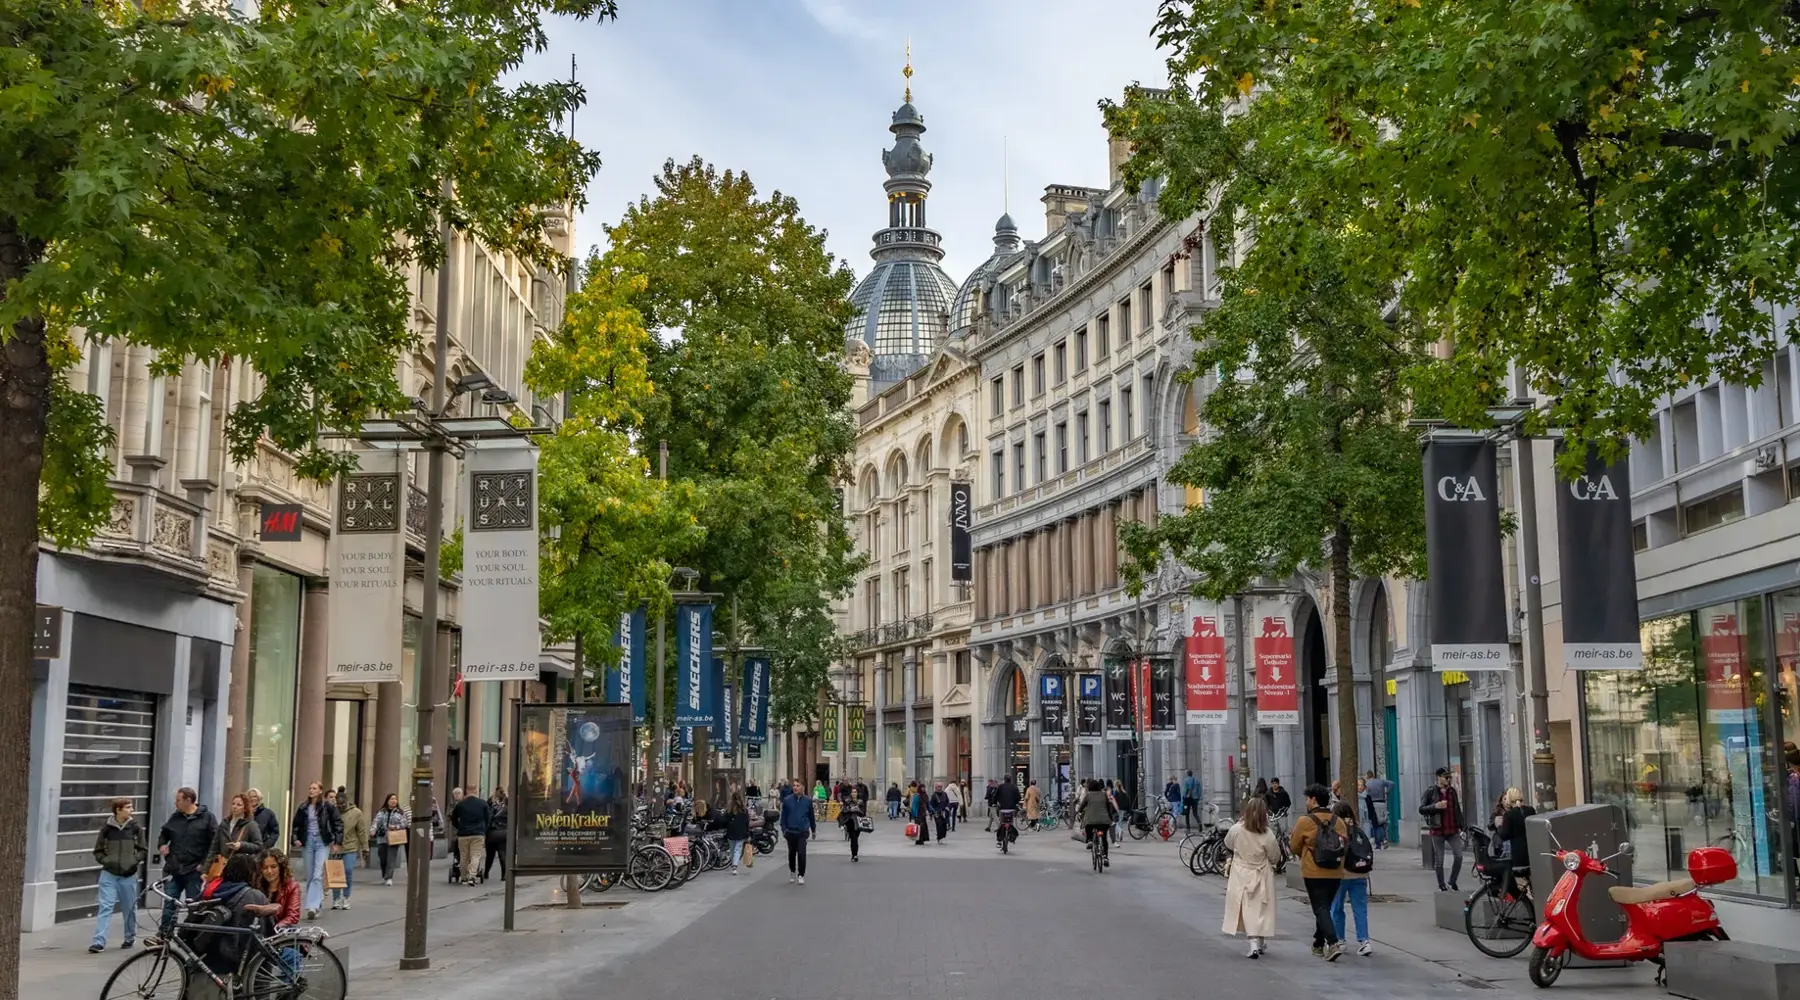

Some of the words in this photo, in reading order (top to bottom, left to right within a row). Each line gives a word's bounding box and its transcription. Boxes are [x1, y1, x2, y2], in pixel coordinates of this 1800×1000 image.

[1437, 476, 1486, 501] C&A
[1570, 475, 1619, 500] C&A
[955, 490, 968, 530] INNO
[341, 552, 367, 561] YOUR
[475, 550, 501, 559] YOUR
[341, 566, 367, 575] YOUR
[475, 564, 501, 572] YOUR
[334, 580, 360, 588] YOUR
[469, 578, 494, 586] YOUR
[1442, 649, 1500, 660] meir-as.be
[1574, 649, 1633, 659] meir-as.be
[336, 661, 393, 672] meir-as.be
[689, 611, 701, 711] SKECHERS
[466, 662, 535, 673] meir-as.be
[1046, 678, 1058, 694] P
[1085, 678, 1097, 694] P
[748, 662, 762, 733] SKECHERS
[724, 688, 732, 744] SKECHERS
